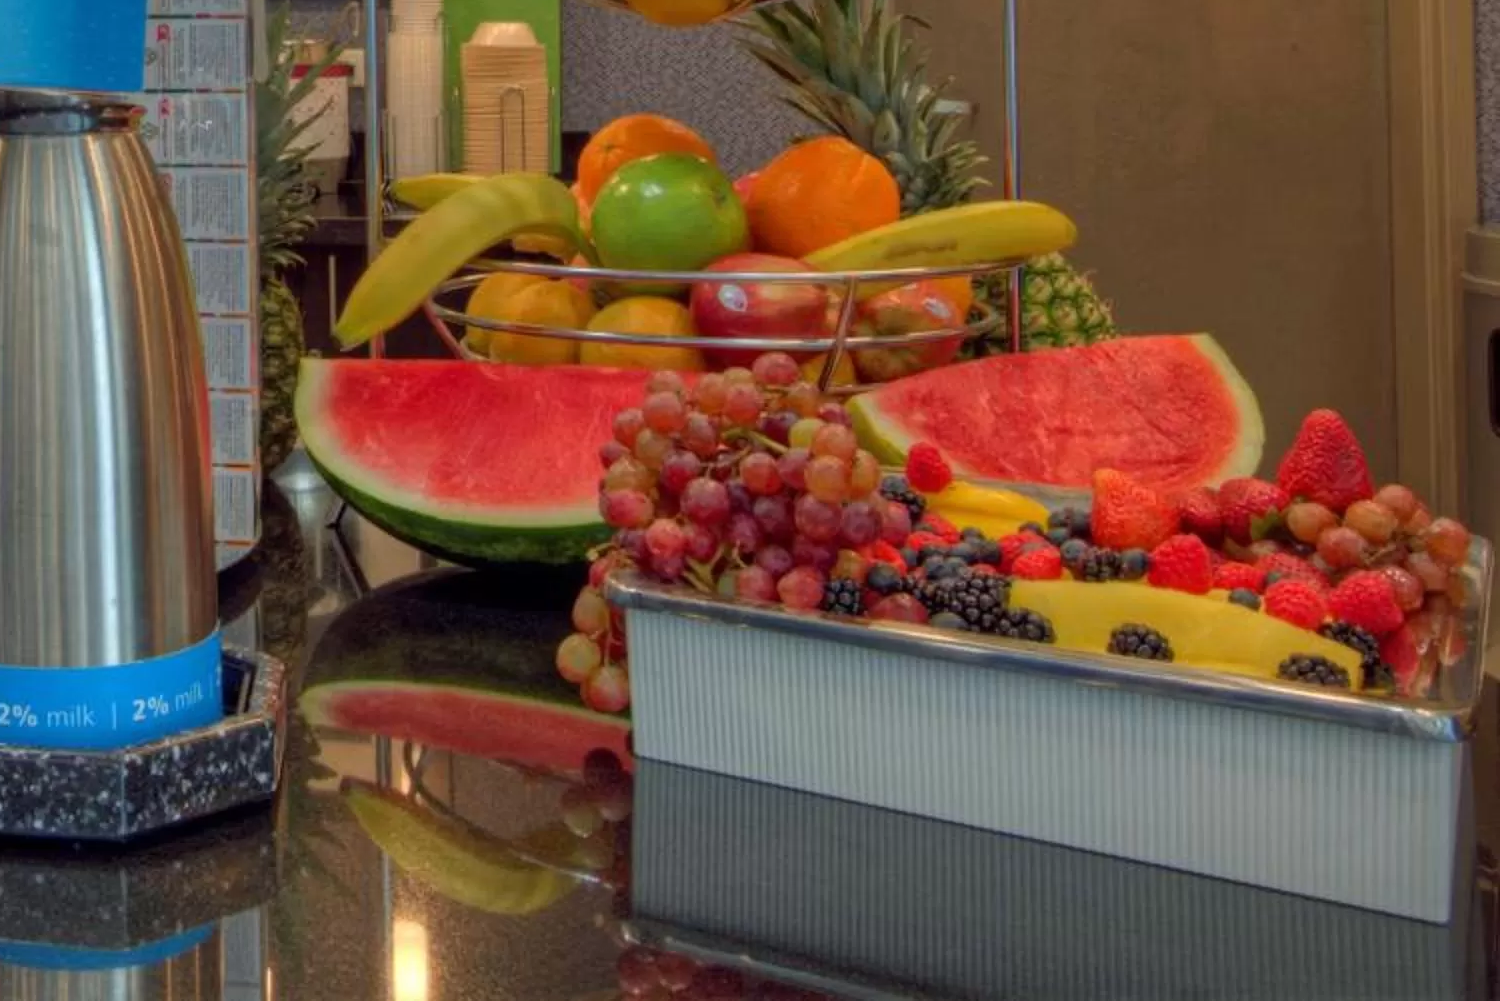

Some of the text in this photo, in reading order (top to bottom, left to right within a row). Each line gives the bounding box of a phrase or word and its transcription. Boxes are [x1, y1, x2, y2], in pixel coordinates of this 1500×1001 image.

[47, 705, 97, 729] milk
[132, 694, 170, 722] 2%
[175, 679, 204, 712] milk
